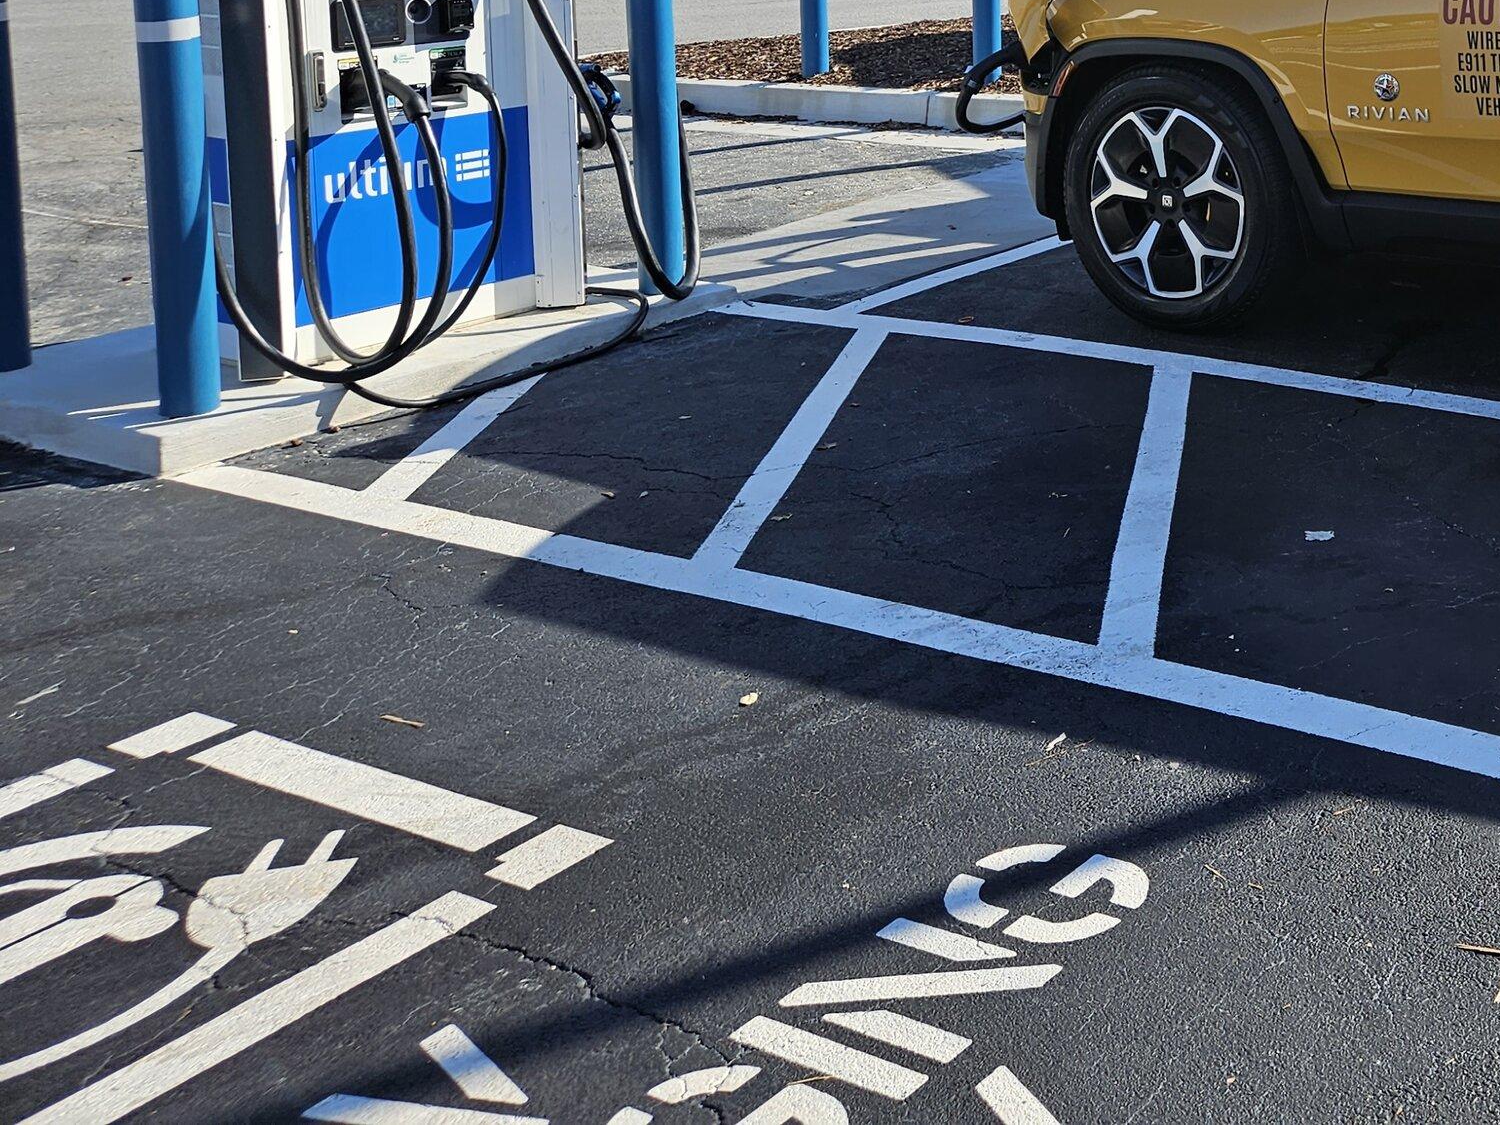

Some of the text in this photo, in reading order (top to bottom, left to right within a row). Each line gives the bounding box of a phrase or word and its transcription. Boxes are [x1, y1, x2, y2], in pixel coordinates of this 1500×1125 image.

[1457, 53, 1487, 73] E911
[1454, 75, 1491, 95] SLOW
[1346, 104, 1431, 123] RIVIAN
